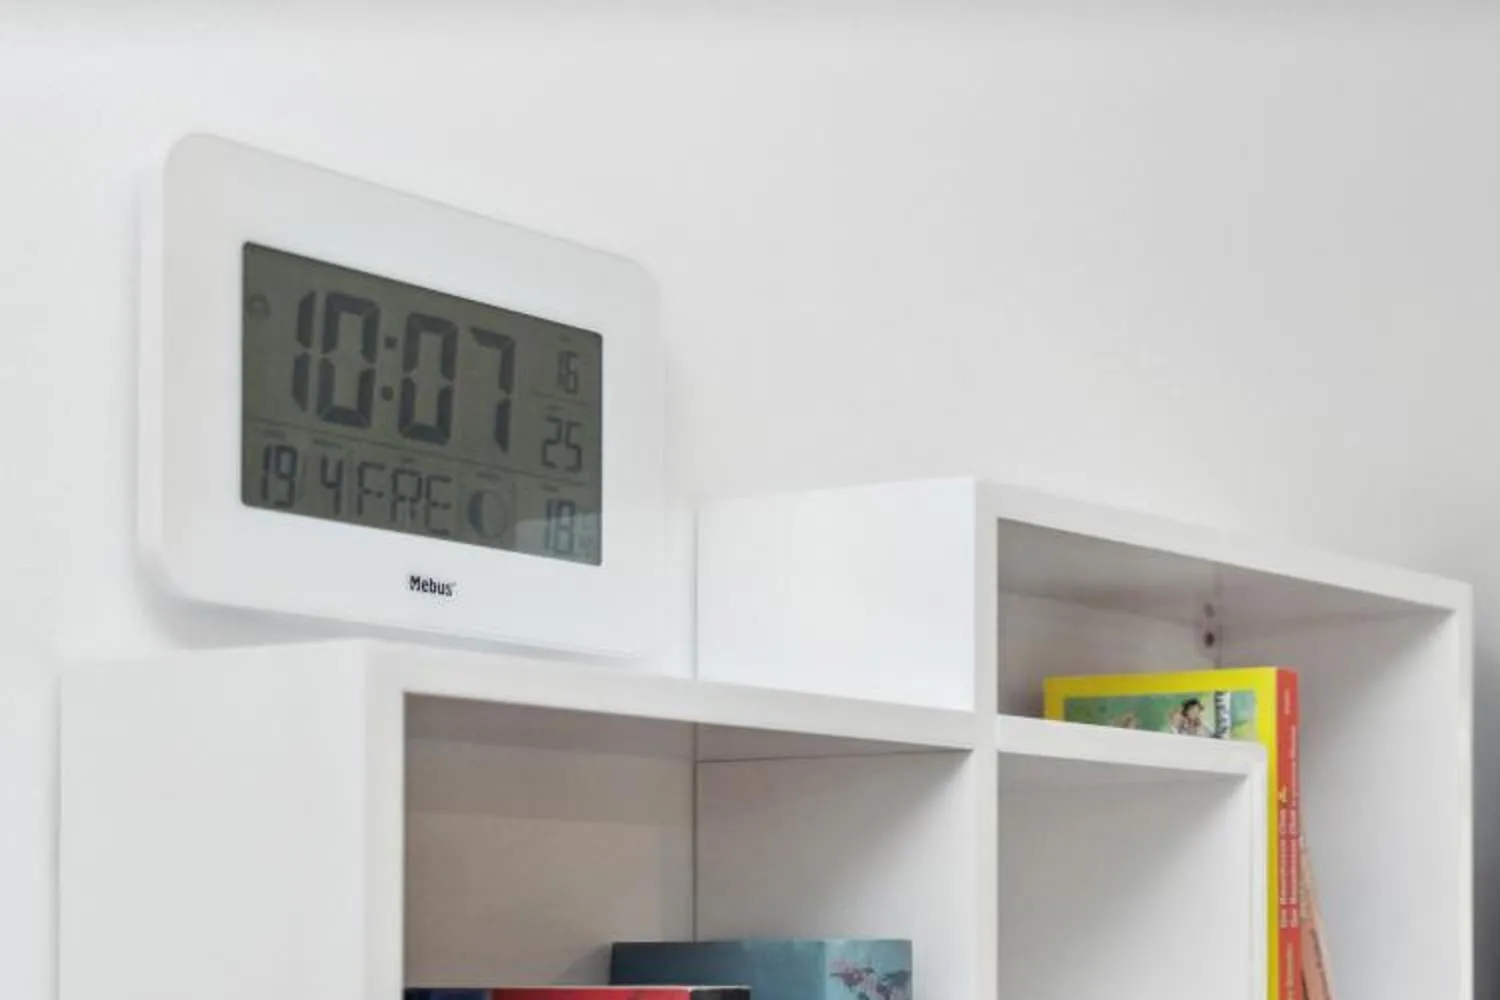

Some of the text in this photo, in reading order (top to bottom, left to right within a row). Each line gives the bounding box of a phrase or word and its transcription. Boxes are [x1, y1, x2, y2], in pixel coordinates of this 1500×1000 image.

[291, 290, 515, 453] 10:07
[541, 416, 582, 474] 25
[260, 445, 453, 535] 19 4 FRE
[409, 575, 453, 597] Mebus
